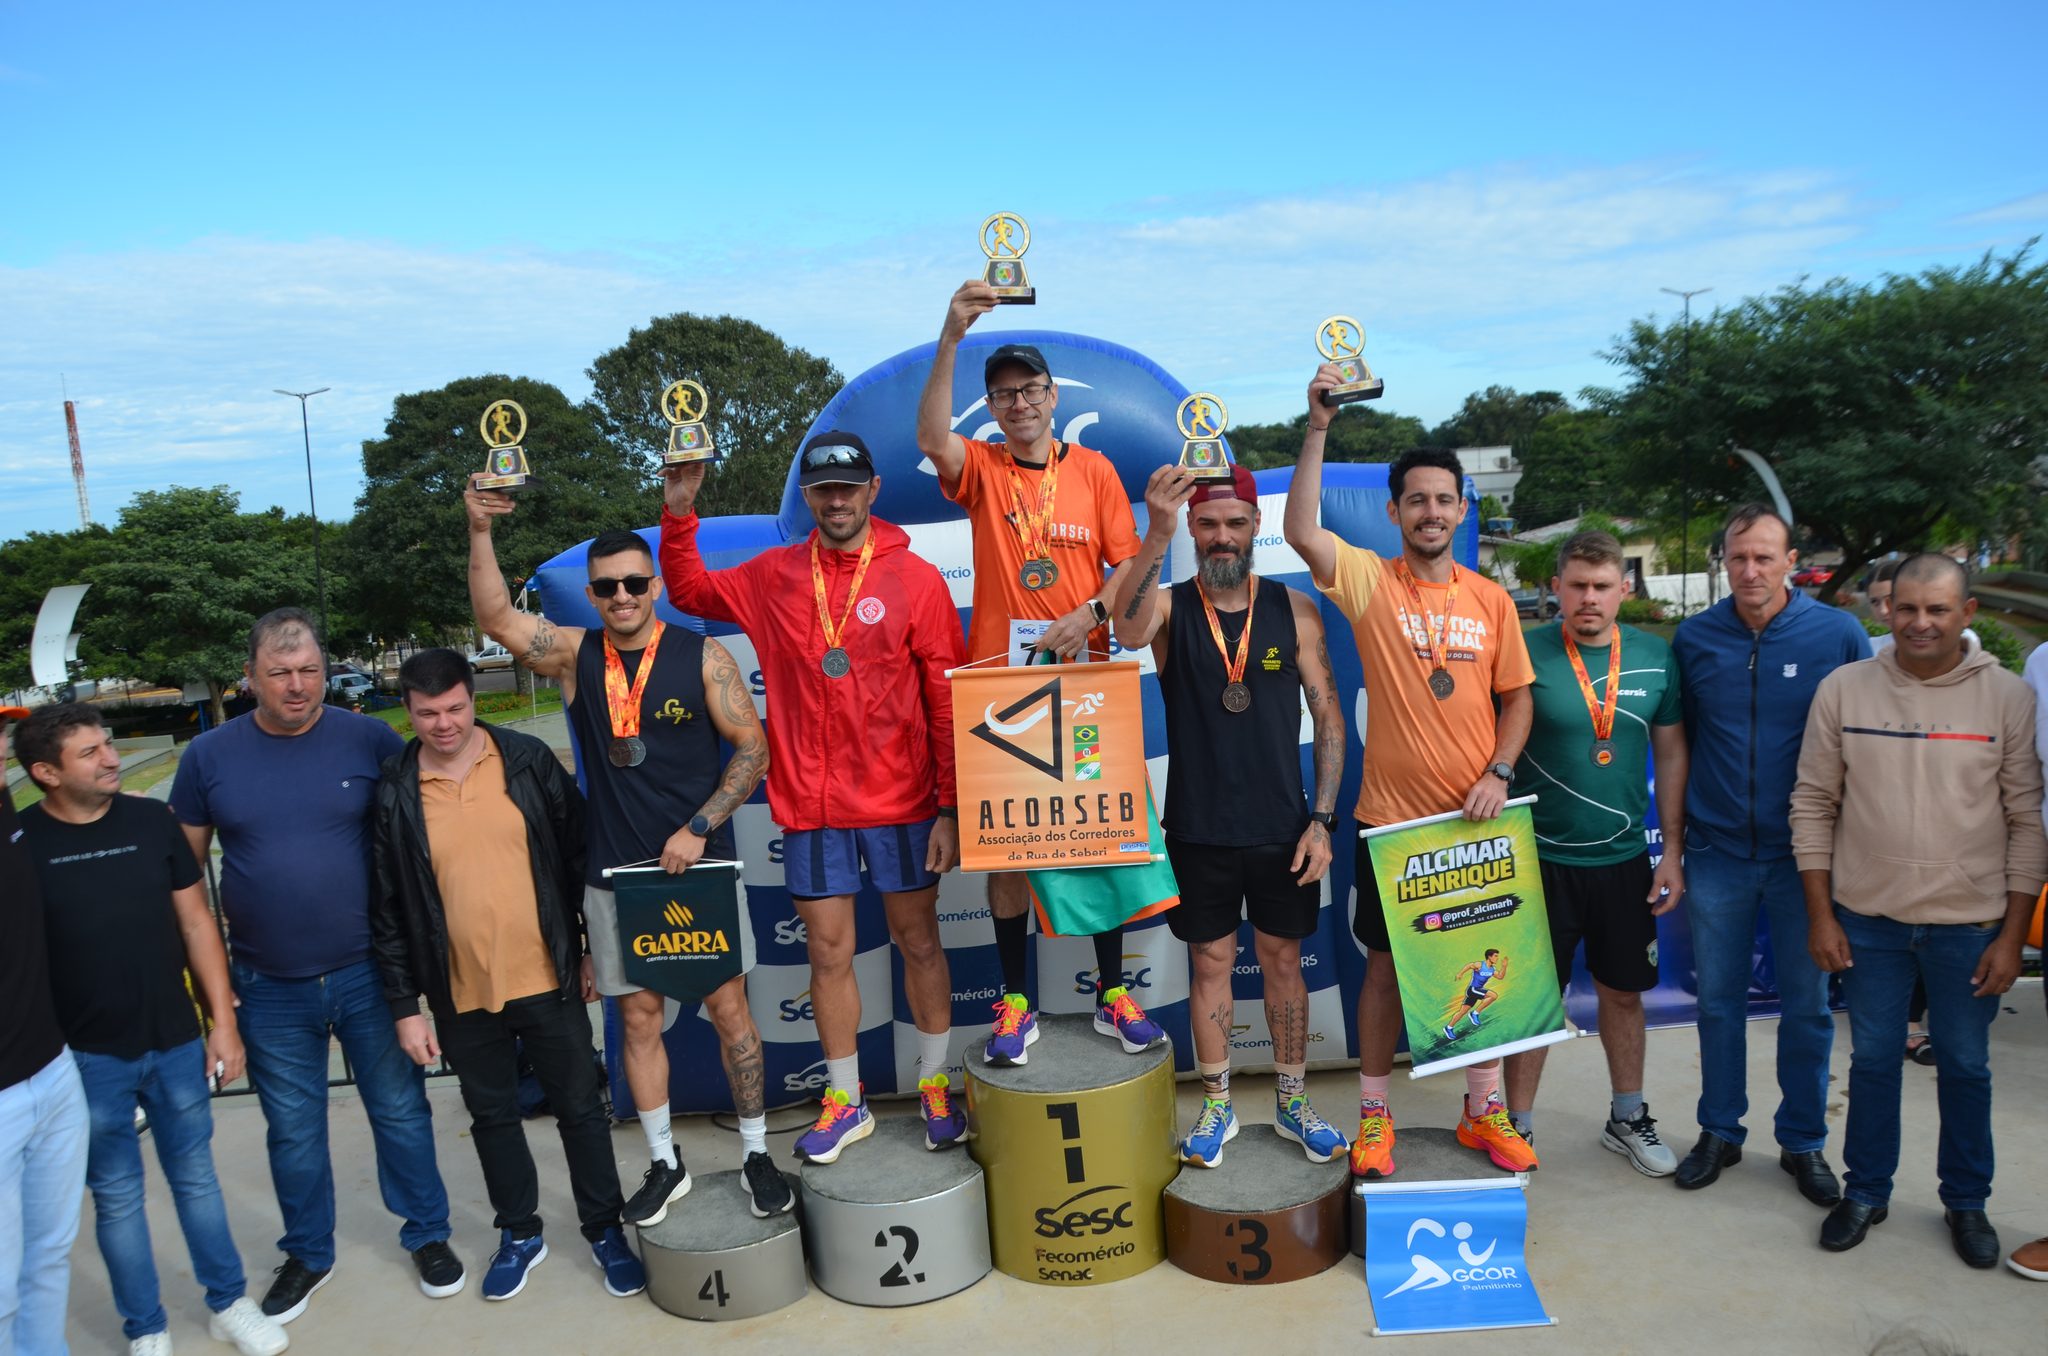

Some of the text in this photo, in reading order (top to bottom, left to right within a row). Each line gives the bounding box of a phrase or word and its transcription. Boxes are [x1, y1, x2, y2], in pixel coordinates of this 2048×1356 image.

[1050, 522, 1090, 541] ORSEB
[1883, 722, 1953, 732] PARIS
[979, 791, 1135, 830] ACORSEB
[977, 827, 1136, 846] Associação dos Corredores
[1007, 846, 1108, 861] de Rua de Seberi
[1405, 836, 1511, 879] ALCIMAR
[1400, 858, 1513, 901] HENRIQUE
[1442, 898, 1513, 923] @prof_alcimarh
[632, 929, 730, 957] GARRA
[646, 955, 668, 963] centro
[678, 953, 720, 961] treinamento
[1046, 1102, 1086, 1184] 1
[874, 1225, 926, 1288] 2
[1034, 1241, 1136, 1264] Fecomércio
[1225, 1218, 1272, 1281] 3
[1038, 1267, 1094, 1281] Senac
[1452, 1266, 1518, 1283] GCOR
[1462, 1281, 1521, 1291] Palmitinho
[698, 1269, 731, 1307] 4
